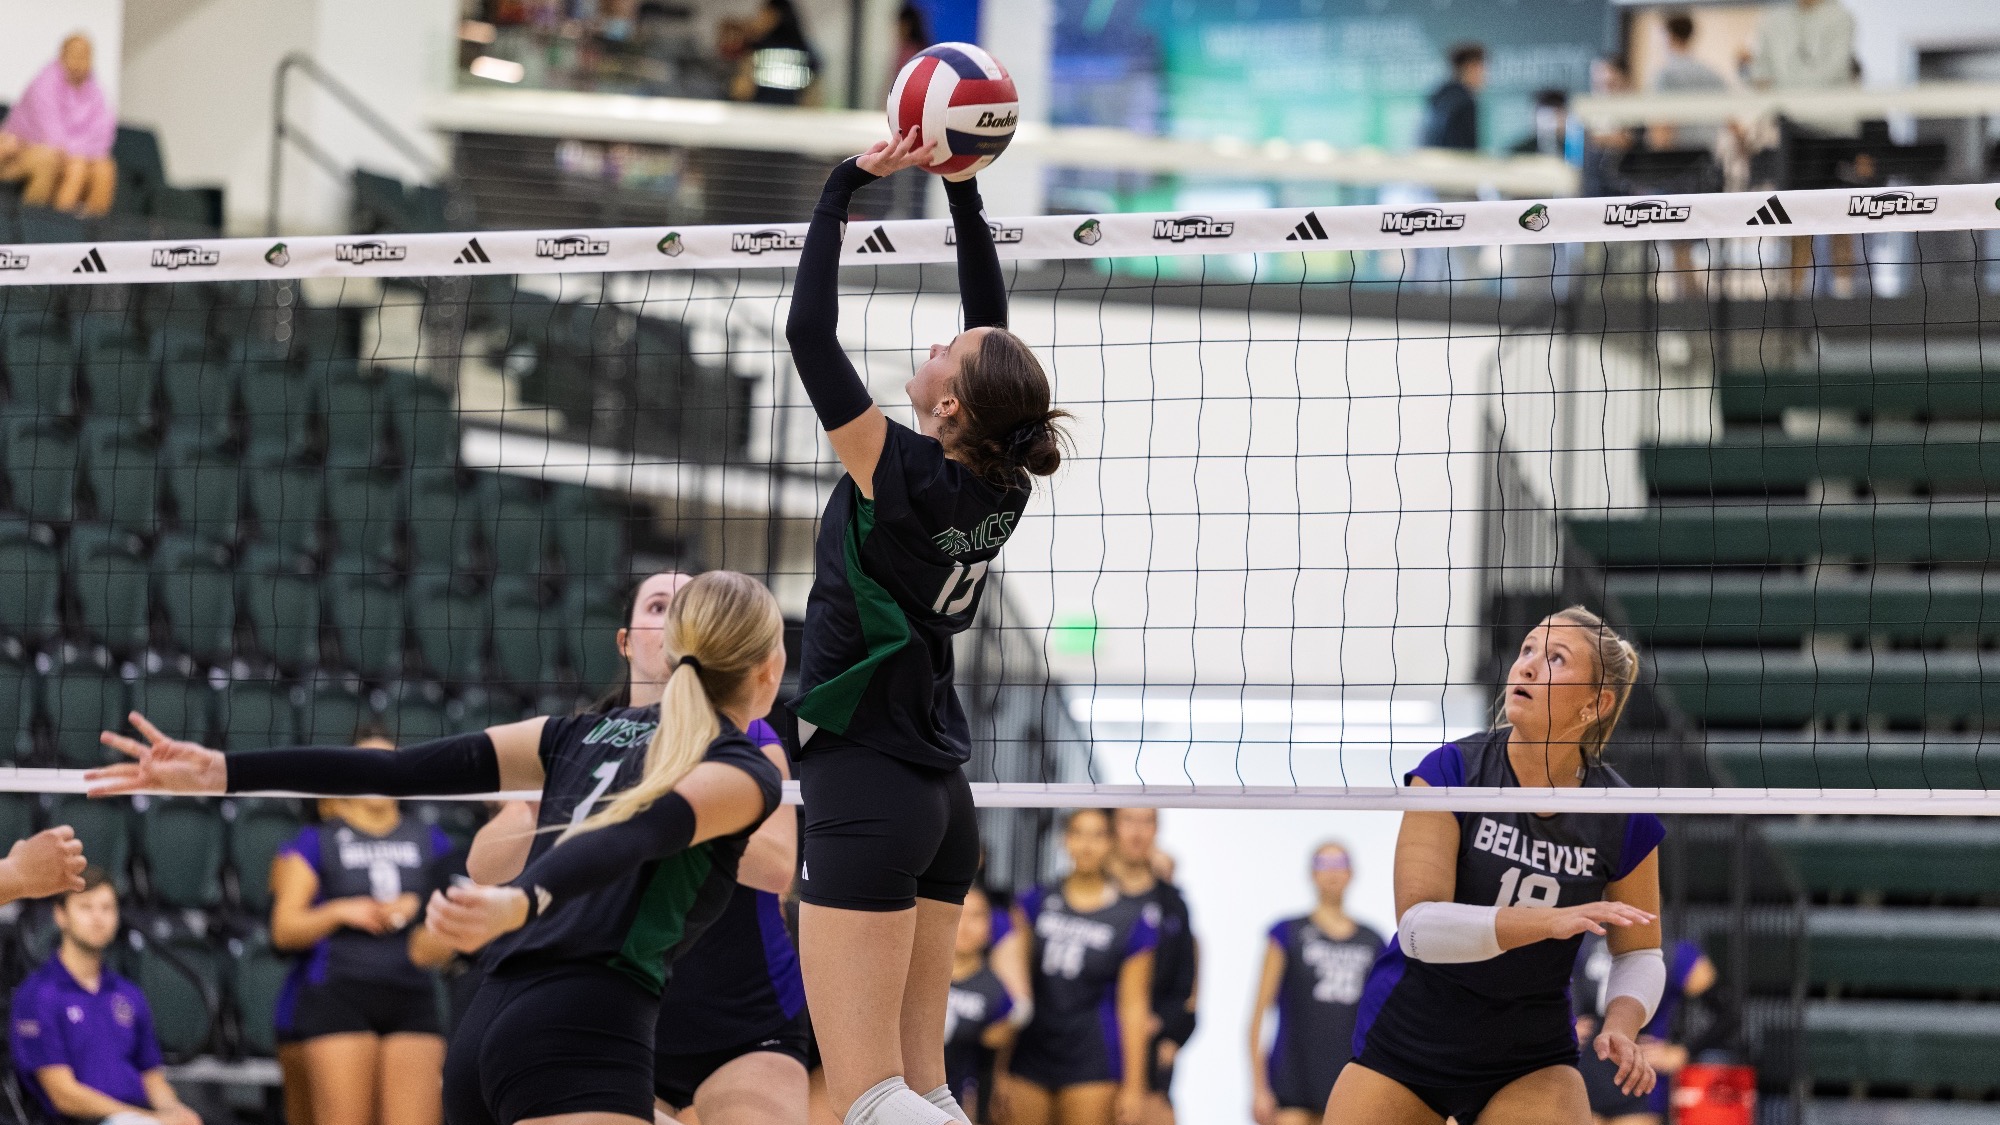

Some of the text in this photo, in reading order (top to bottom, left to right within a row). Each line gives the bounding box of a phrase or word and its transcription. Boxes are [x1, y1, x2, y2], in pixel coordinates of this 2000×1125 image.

[1604, 200, 1691, 227] Mystics
[1848, 191, 1938, 219] Mystics
[1153, 215, 1235, 241] Mystics
[1381, 208, 1466, 235] Mystics
[336, 240, 406, 264] Mystics
[536, 235, 609, 259] Mystics
[732, 229, 807, 254] Mystics
[152, 246, 219, 270] Mystics
[1474, 817, 1596, 877] BELLEVUE
